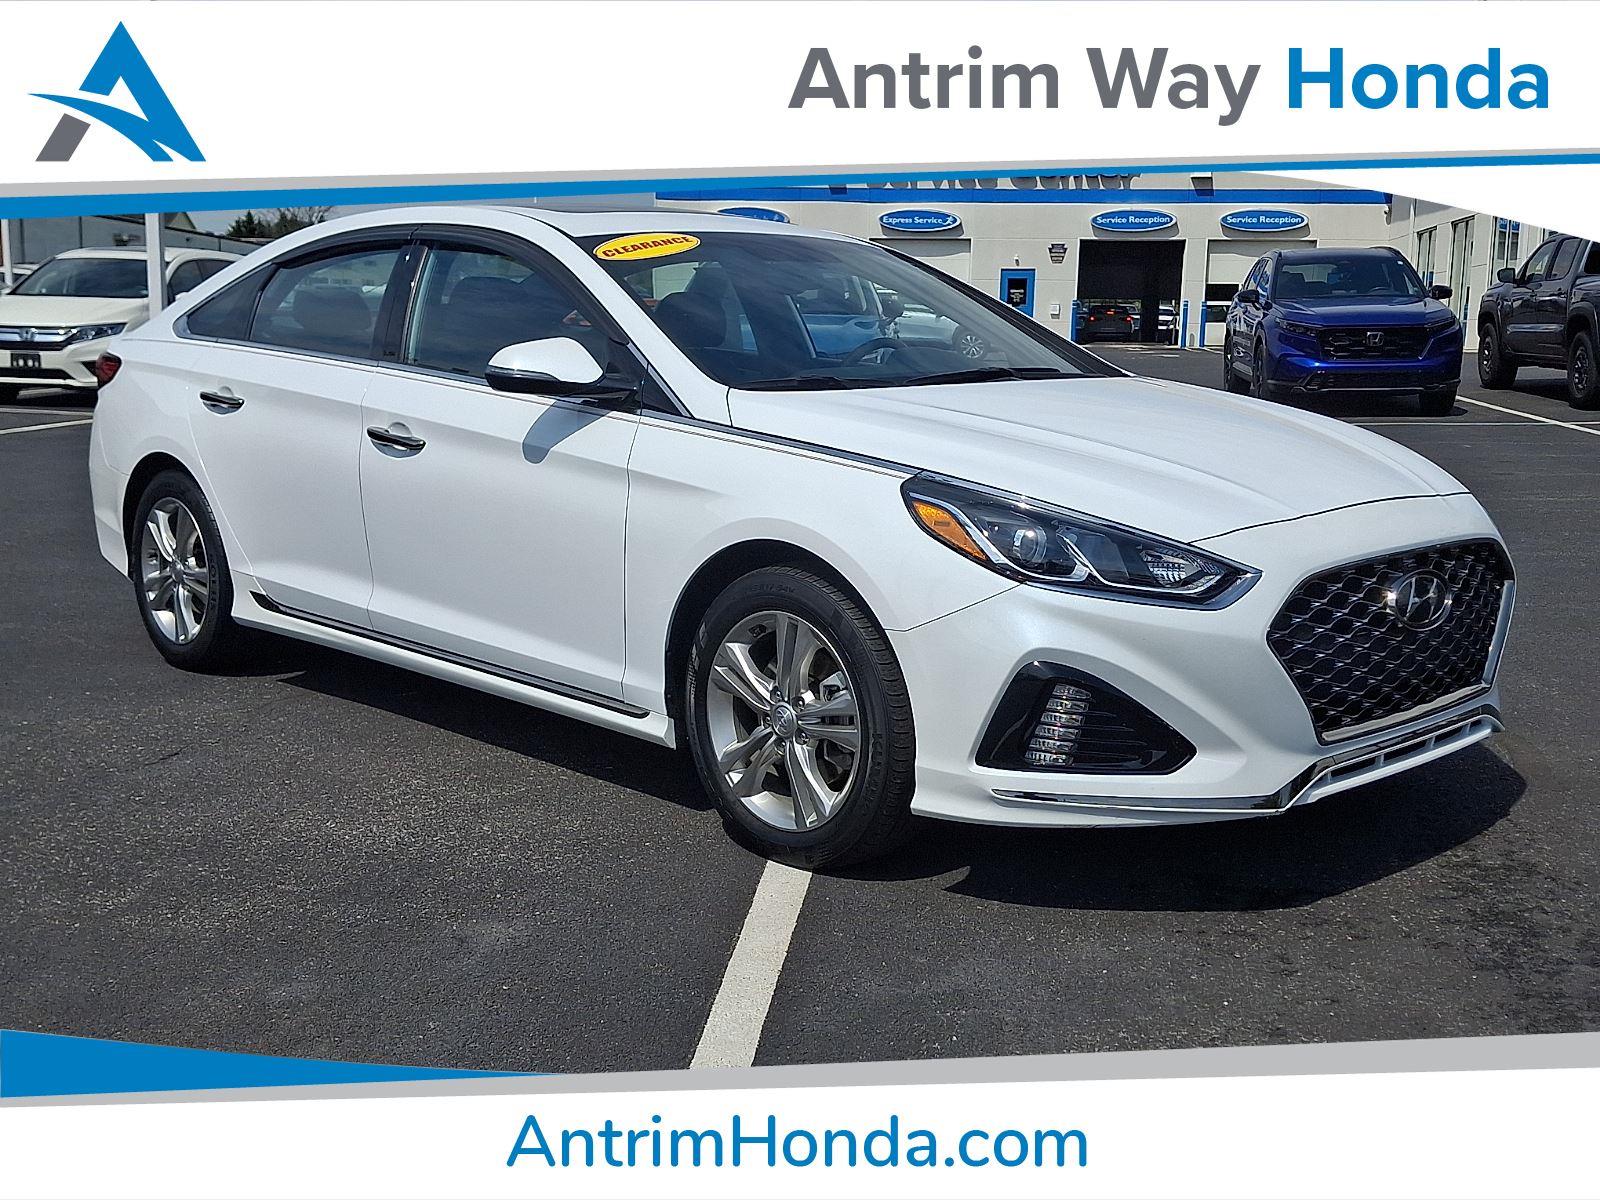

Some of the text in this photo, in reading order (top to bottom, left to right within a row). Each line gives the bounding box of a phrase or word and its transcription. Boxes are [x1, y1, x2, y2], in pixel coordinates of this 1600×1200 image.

[882, 215, 943, 225] Express Service
[1096, 215, 1171, 225] Service Reception
[1226, 215, 1302, 225] Service Reception
[601, 236, 693, 258] CLEARANCE
